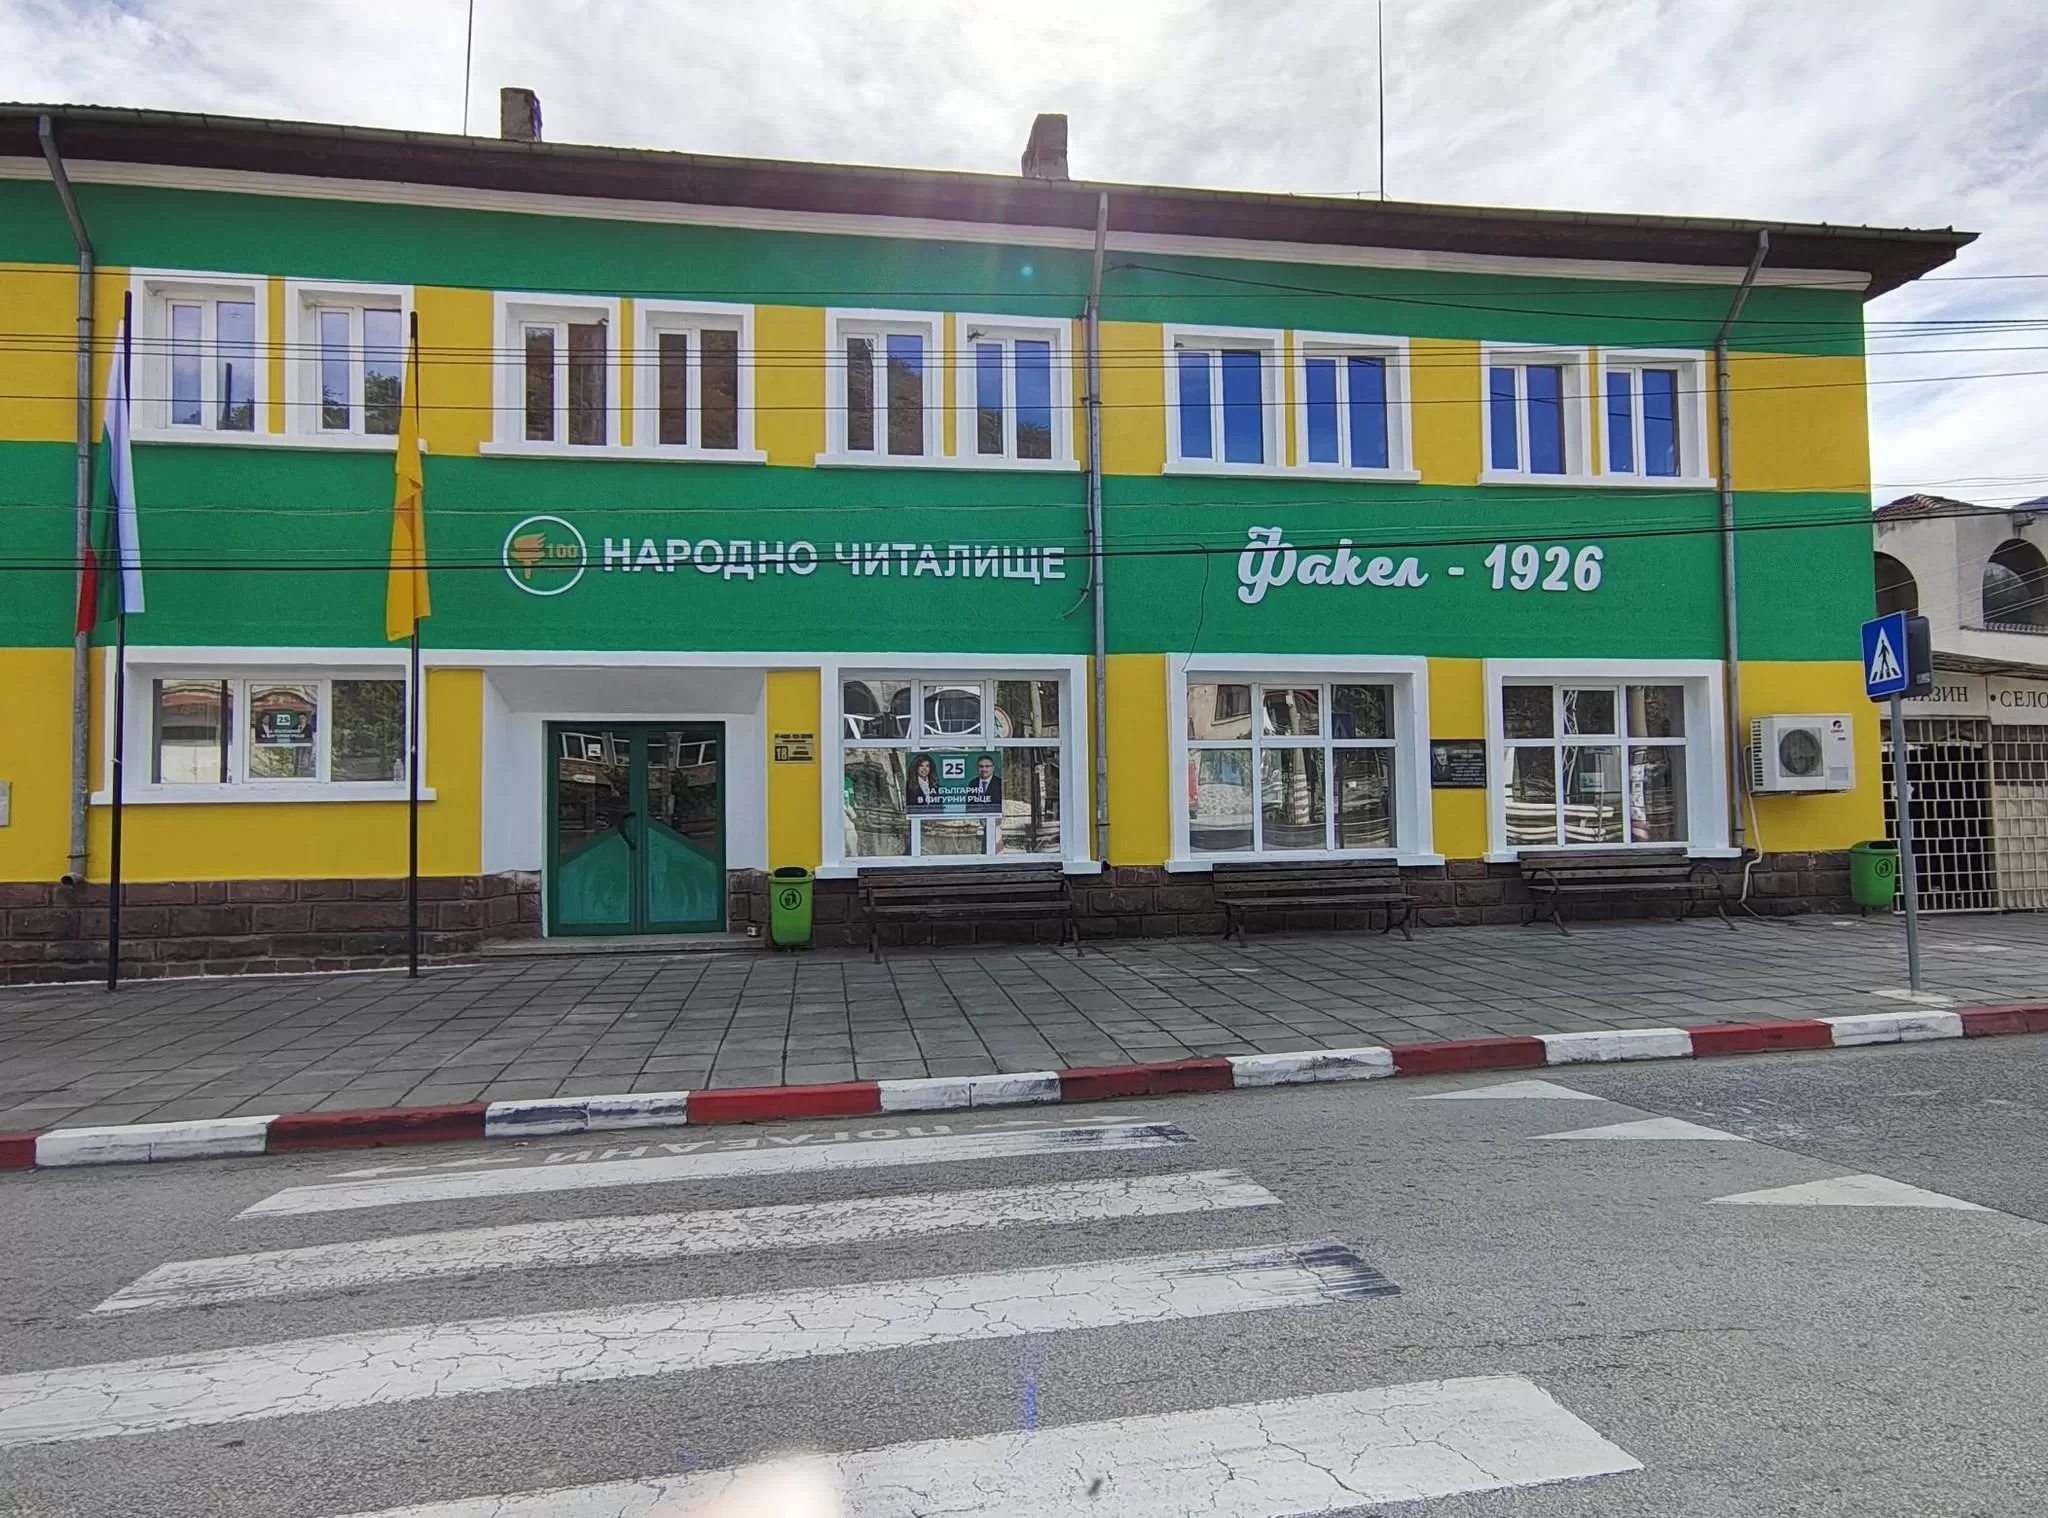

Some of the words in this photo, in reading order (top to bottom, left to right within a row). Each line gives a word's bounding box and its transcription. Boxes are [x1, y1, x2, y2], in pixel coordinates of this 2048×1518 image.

[546, 544, 577, 558] 100
[603, 537, 818, 580] НАРОДНО
[835, 542, 1066, 584] ЧИТАЛИЩЕ
[1237, 526, 1429, 604] Факел
[1484, 543, 1604, 592] 1926
[278, 716, 290, 724] 25
[945, 763, 964, 775] 25
[938, 786, 984, 795] БЪЛГАРИЯ
[967, 795, 992, 804] РЪЦЕ
[541, 1125, 954, 1162] ПОГЛЕДНИ
